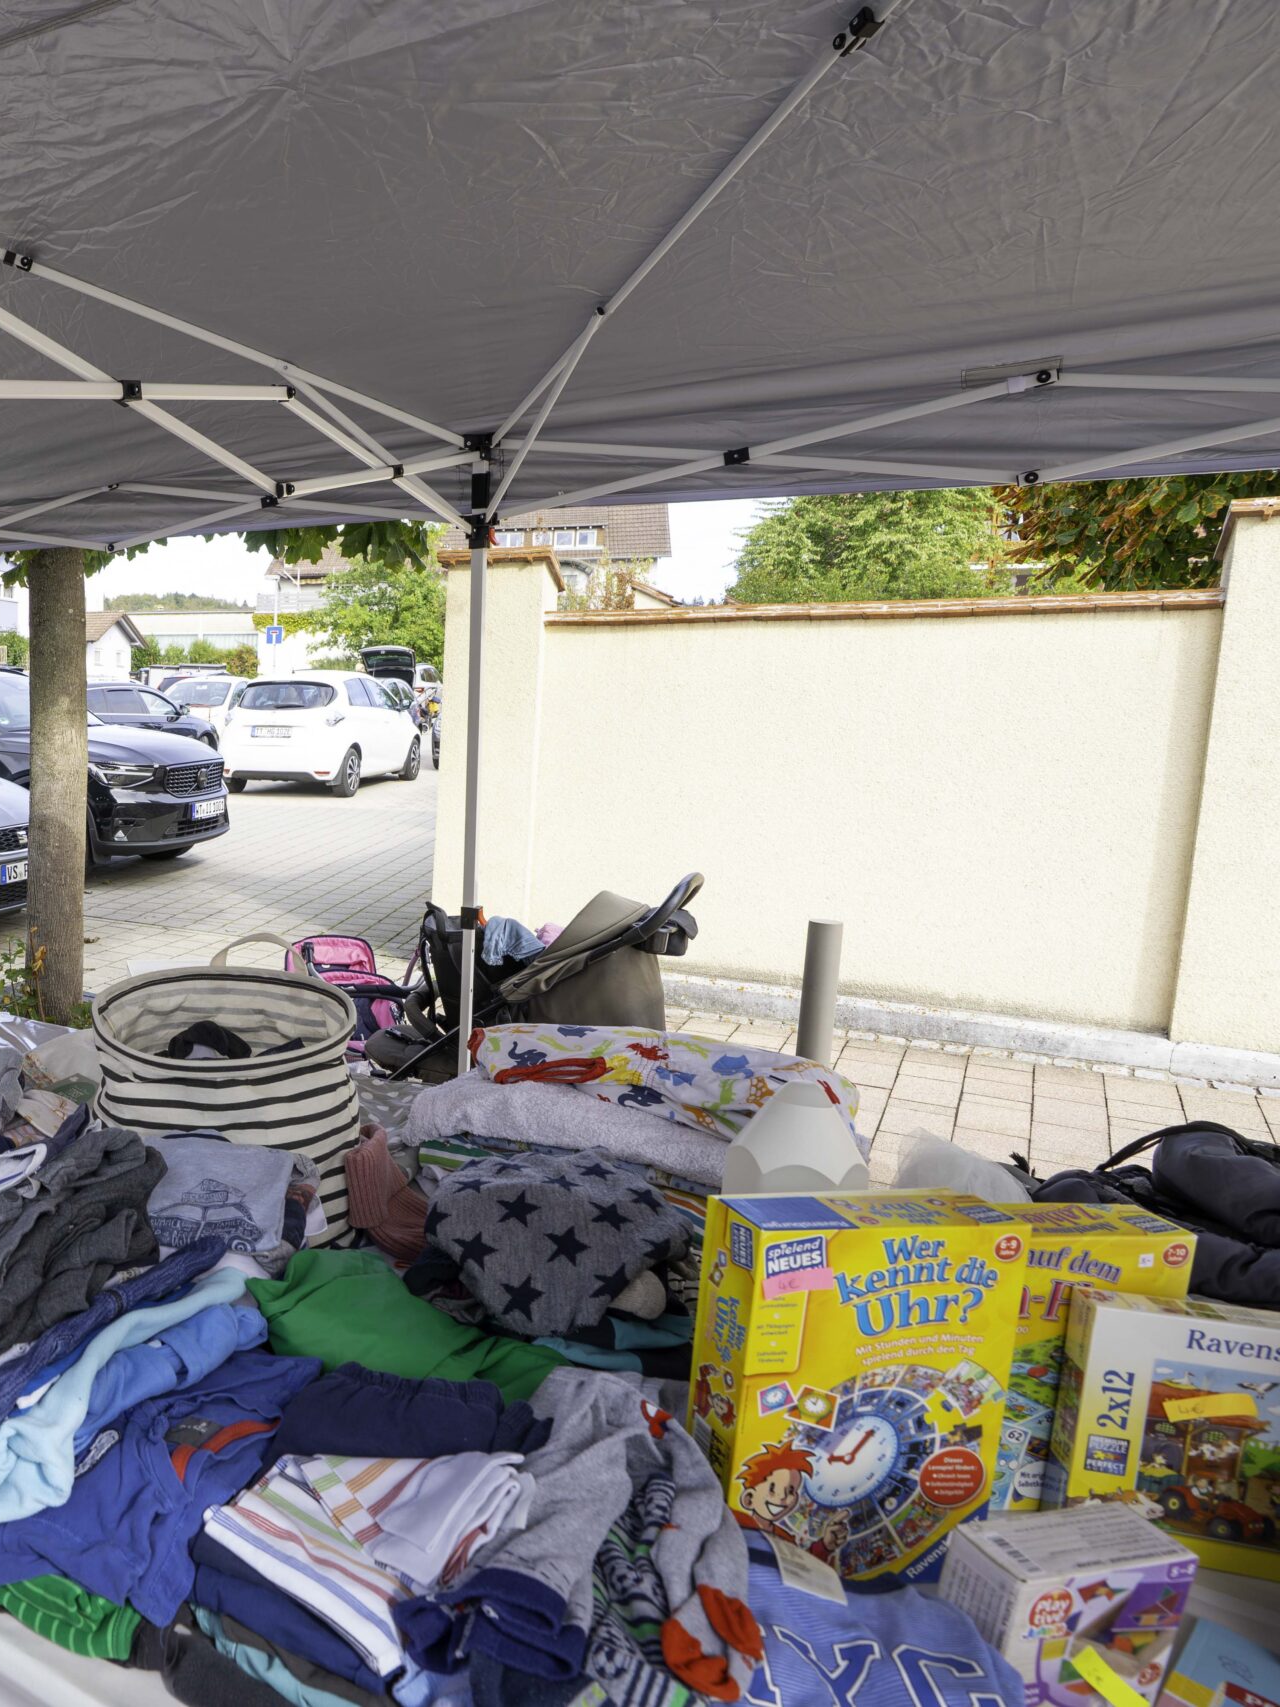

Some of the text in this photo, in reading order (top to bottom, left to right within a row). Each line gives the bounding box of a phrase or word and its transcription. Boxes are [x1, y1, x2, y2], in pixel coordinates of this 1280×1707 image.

[7, 864, 18, 880] VS
[767, 1236, 821, 1261] spielend
[882, 1235, 945, 1265] Wer
[767, 1251, 822, 1274] NEUES
[1070, 1251, 1121, 1284] dem
[834, 1255, 998, 1305] kennt die
[853, 1287, 984, 1338] Uhr?
[855, 1332, 984, 1357] Mit Stunden und Minuten
[862, 1344, 975, 1366] spielend durch den Tag
[1096, 1369, 1136, 1431] 2x12
[1007, 1430, 1023, 1442] 62
